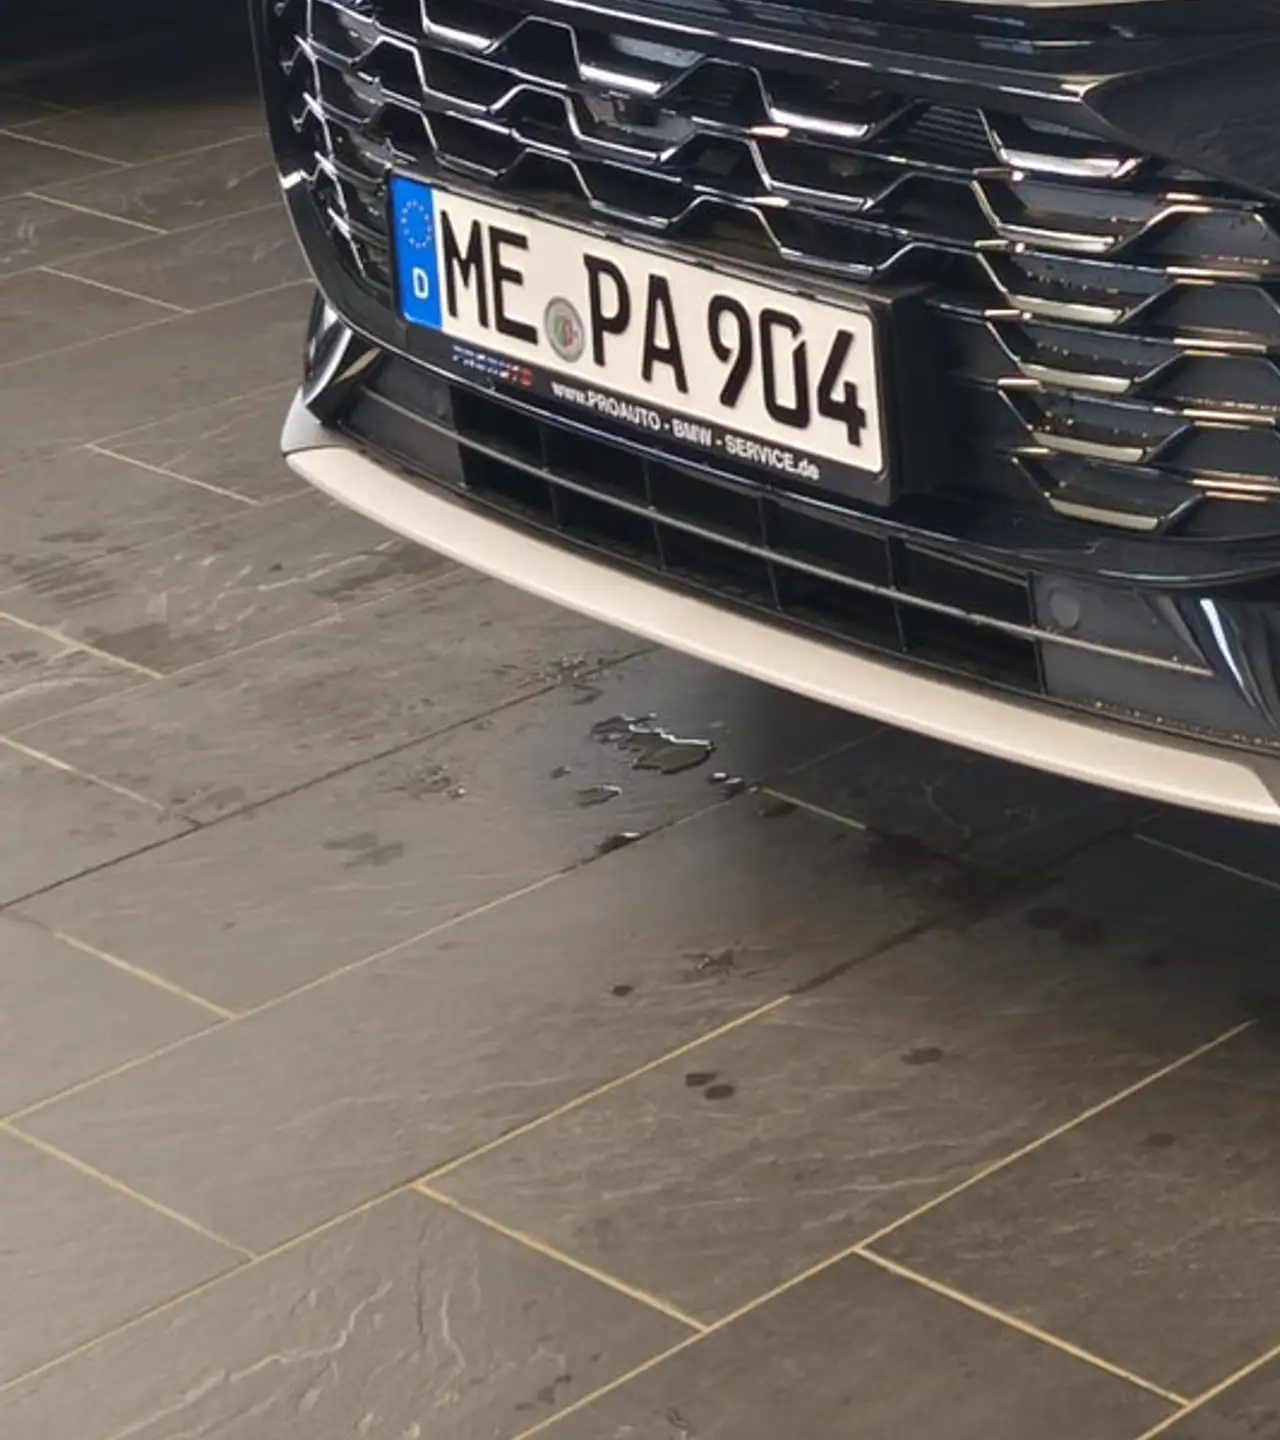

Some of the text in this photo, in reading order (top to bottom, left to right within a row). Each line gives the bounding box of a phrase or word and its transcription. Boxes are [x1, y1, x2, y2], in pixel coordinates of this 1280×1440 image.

[412, 266, 429, 300] D
[440, 209, 867, 448] ME PA 904
[672, 418, 712, 447] BMW
[725, 434, 820, 480] SERVICE.de
